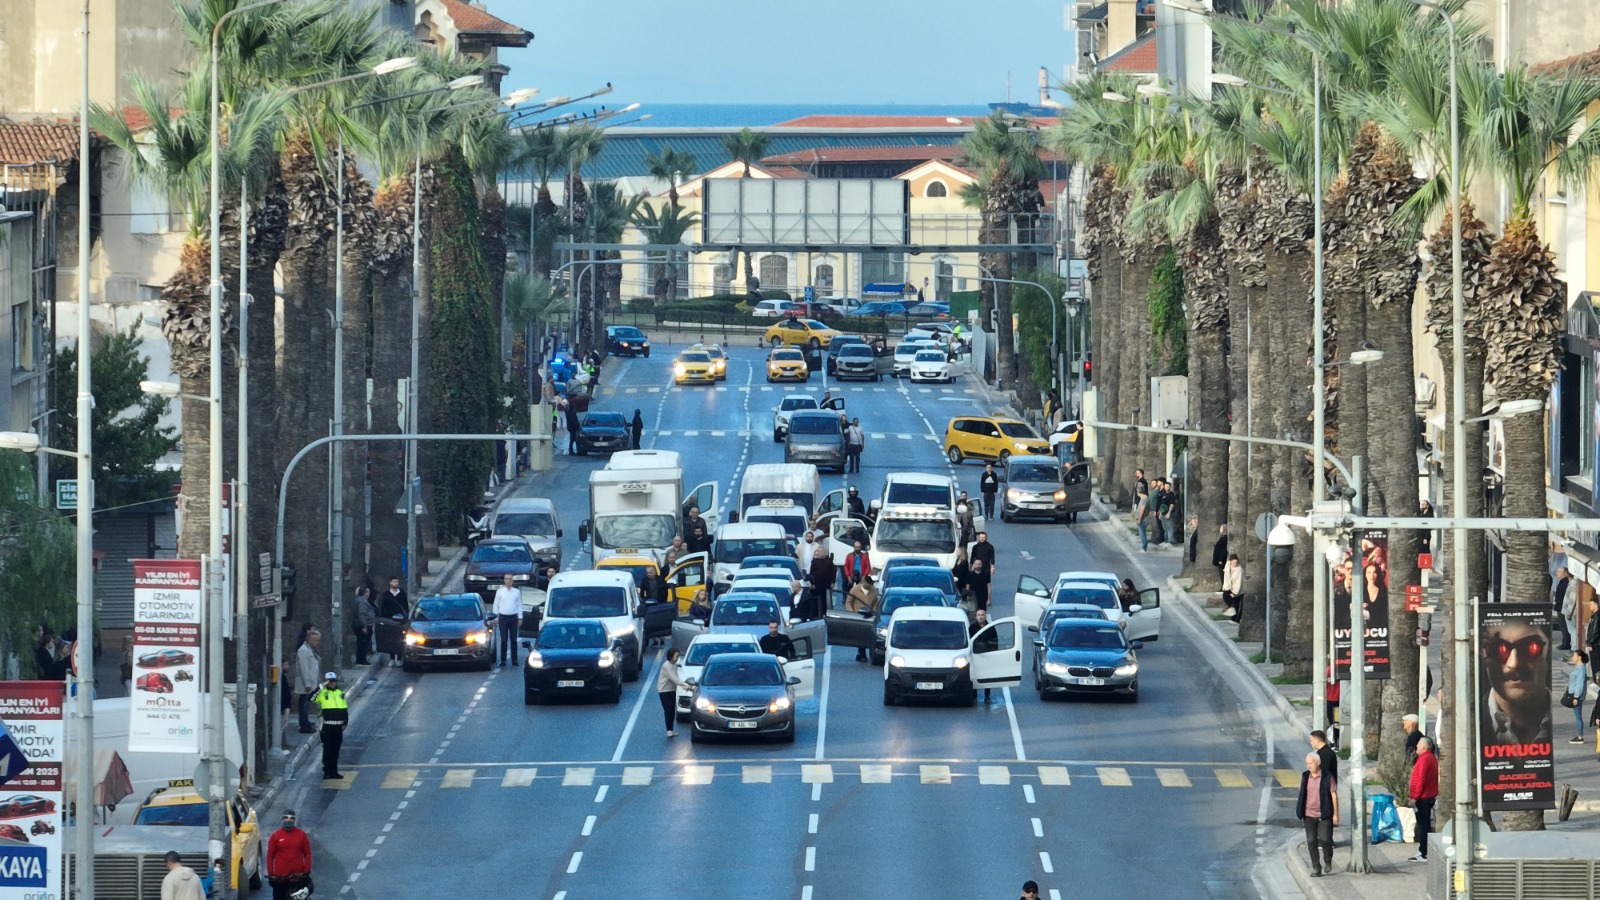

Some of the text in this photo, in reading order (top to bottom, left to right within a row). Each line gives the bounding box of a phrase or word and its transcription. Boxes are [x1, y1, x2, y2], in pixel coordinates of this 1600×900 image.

[153, 592, 180, 600] İZMİR
[139, 602, 194, 610] OTOMOTİV
[139, 611, 194, 620] FUARINDA!
[1335, 628, 1387, 638] UYUCU
[35, 698, 48, 706] İYİ
[146, 697, 181, 706] motta
[6, 722, 36, 734] ZMİR
[1484, 743, 1550, 757] UYKUCU
[1484, 782, 1552, 790] SİNEMALARDA
